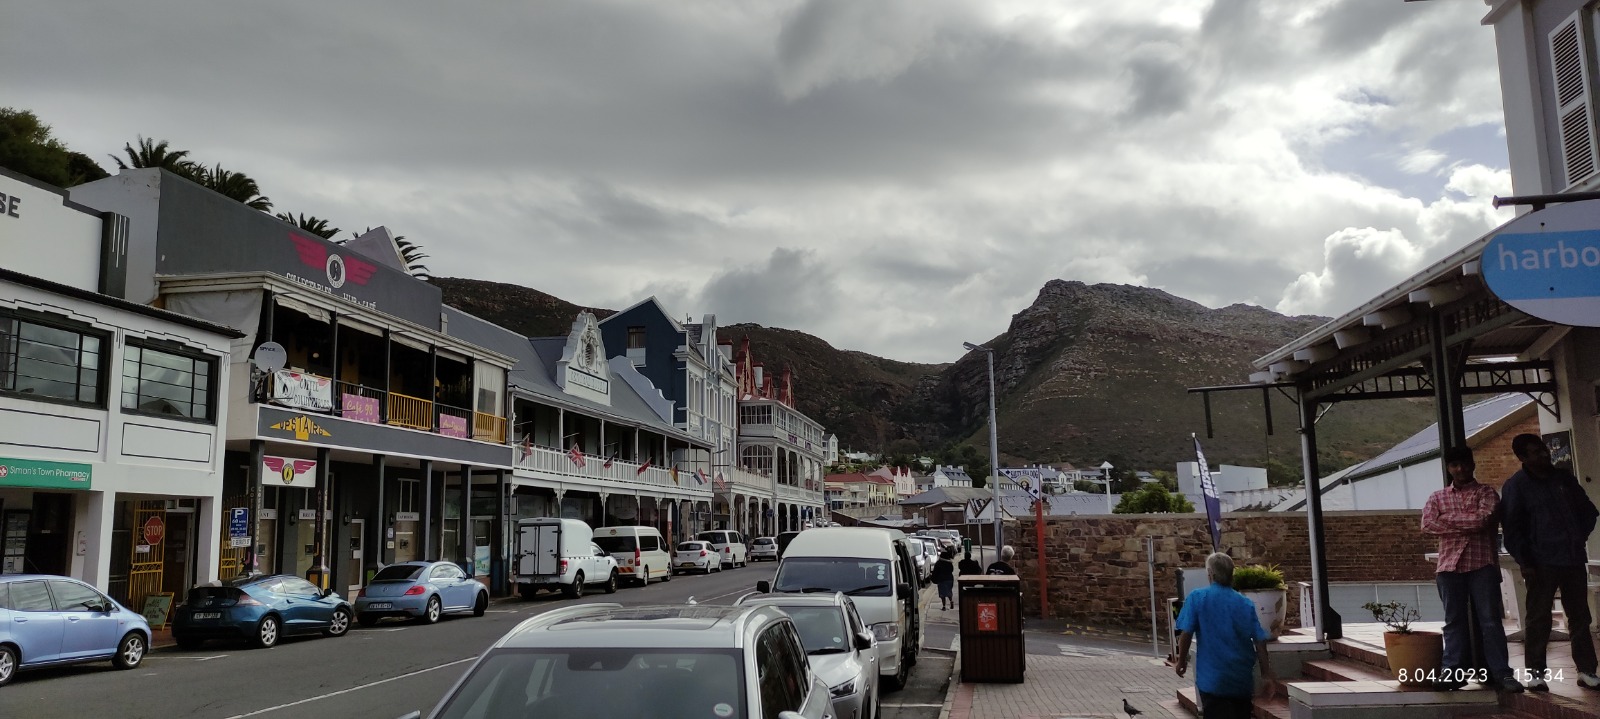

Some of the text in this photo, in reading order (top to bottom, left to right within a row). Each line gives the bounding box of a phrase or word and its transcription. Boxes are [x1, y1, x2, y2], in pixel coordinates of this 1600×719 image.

[10, 466, 37, 476] Simon's
[38, 468, 55, 477] Town
[56, 468, 90, 479] Pharmacy
[234, 509, 244, 519] P
[146, 525, 163, 537] STOP
